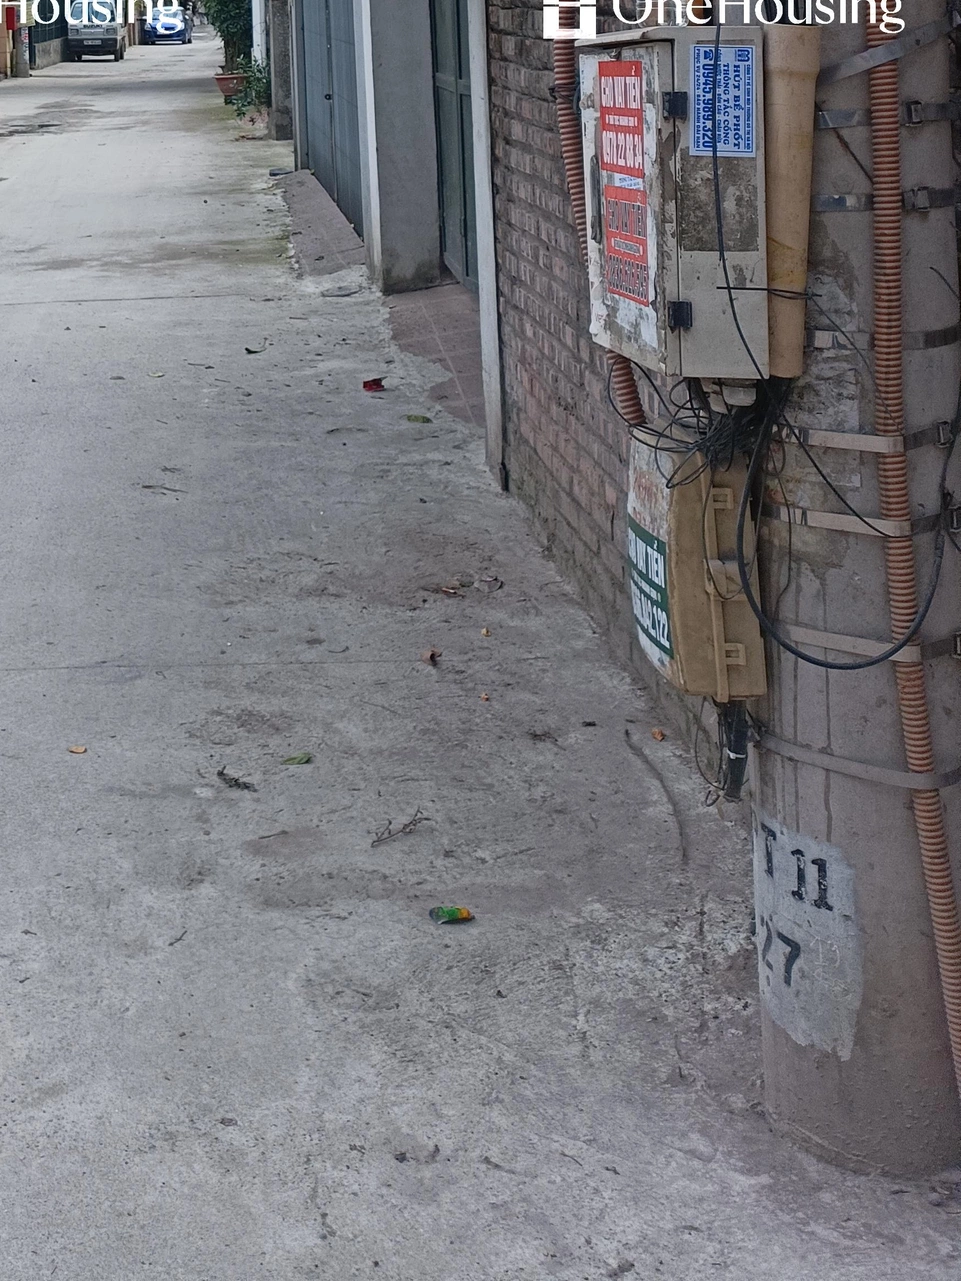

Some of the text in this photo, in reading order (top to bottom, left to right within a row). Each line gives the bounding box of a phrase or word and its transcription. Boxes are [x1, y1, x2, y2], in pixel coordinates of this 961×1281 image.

[601, 76, 614, 108] CHO
[614, 76, 625, 108] VAY
[723, 63, 731, 96] THÔNG
[723, 119, 732, 145] CỐNG
[733, 115, 743, 150] PHỐT
